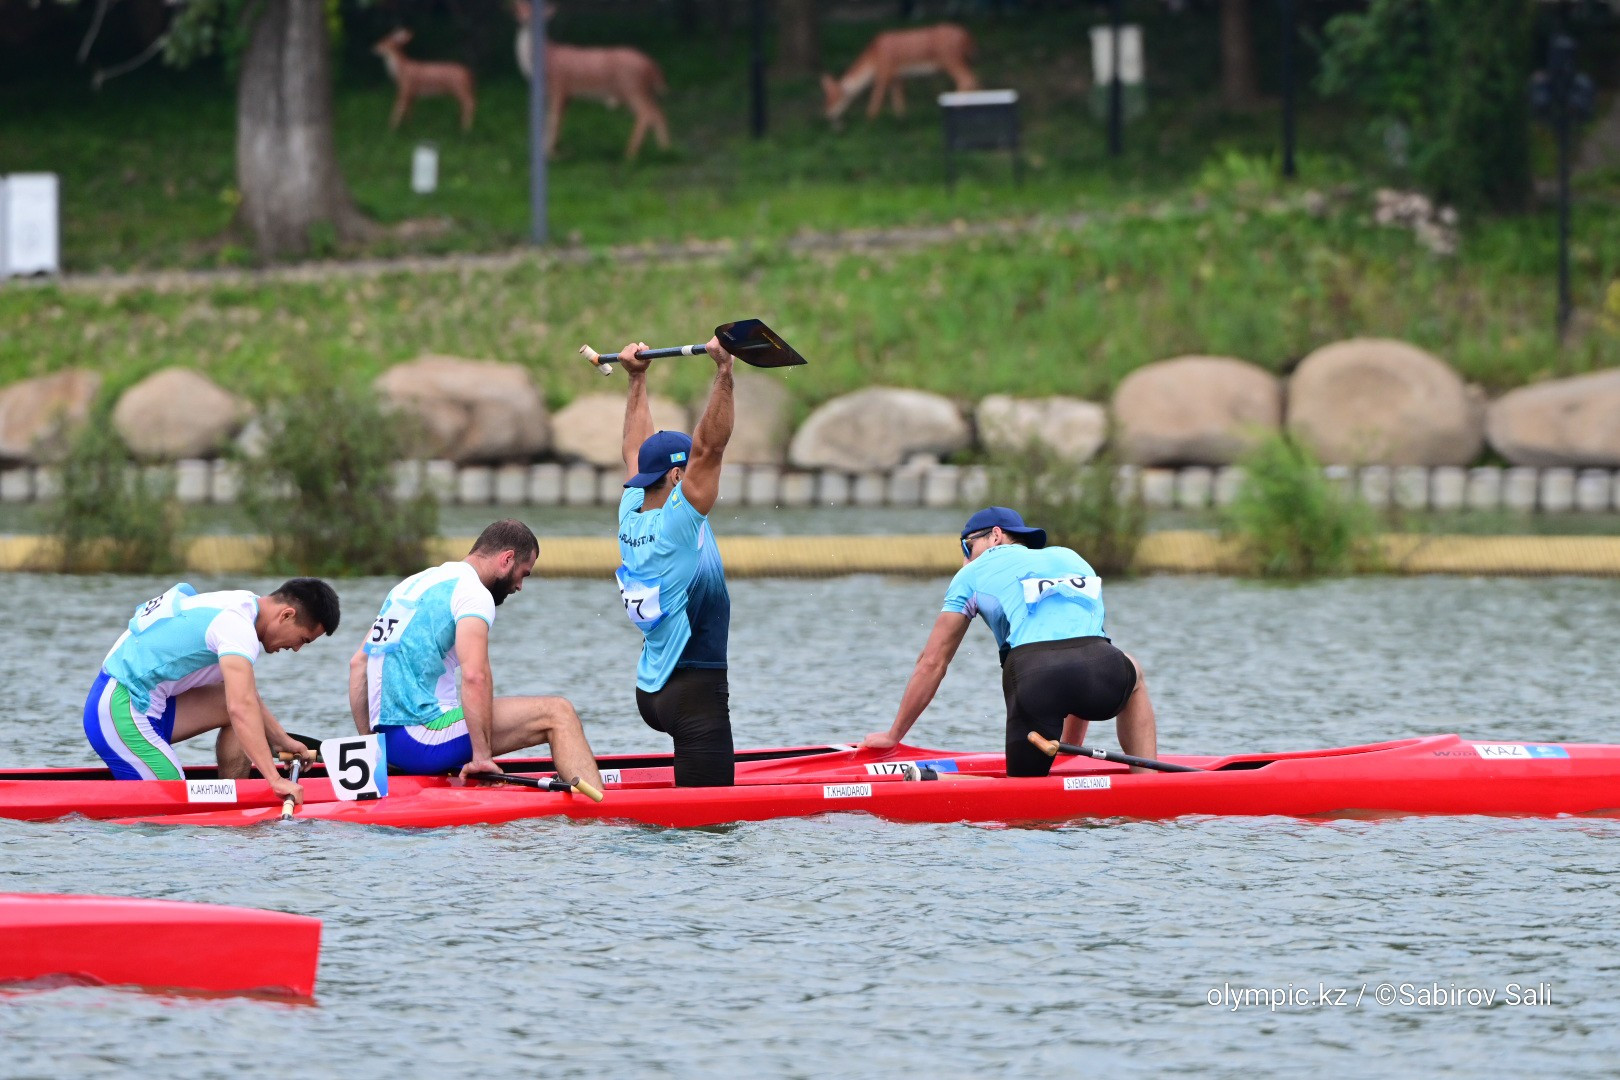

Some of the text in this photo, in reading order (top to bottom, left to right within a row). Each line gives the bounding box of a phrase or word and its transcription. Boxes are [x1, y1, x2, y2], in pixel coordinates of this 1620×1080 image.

[1482, 745, 1523, 756] KAZ
[339, 741, 370, 791] 5
[190, 784, 234, 795] K.AKHTAMOV
[826, 785, 869, 797] T.KHAIDAROV
